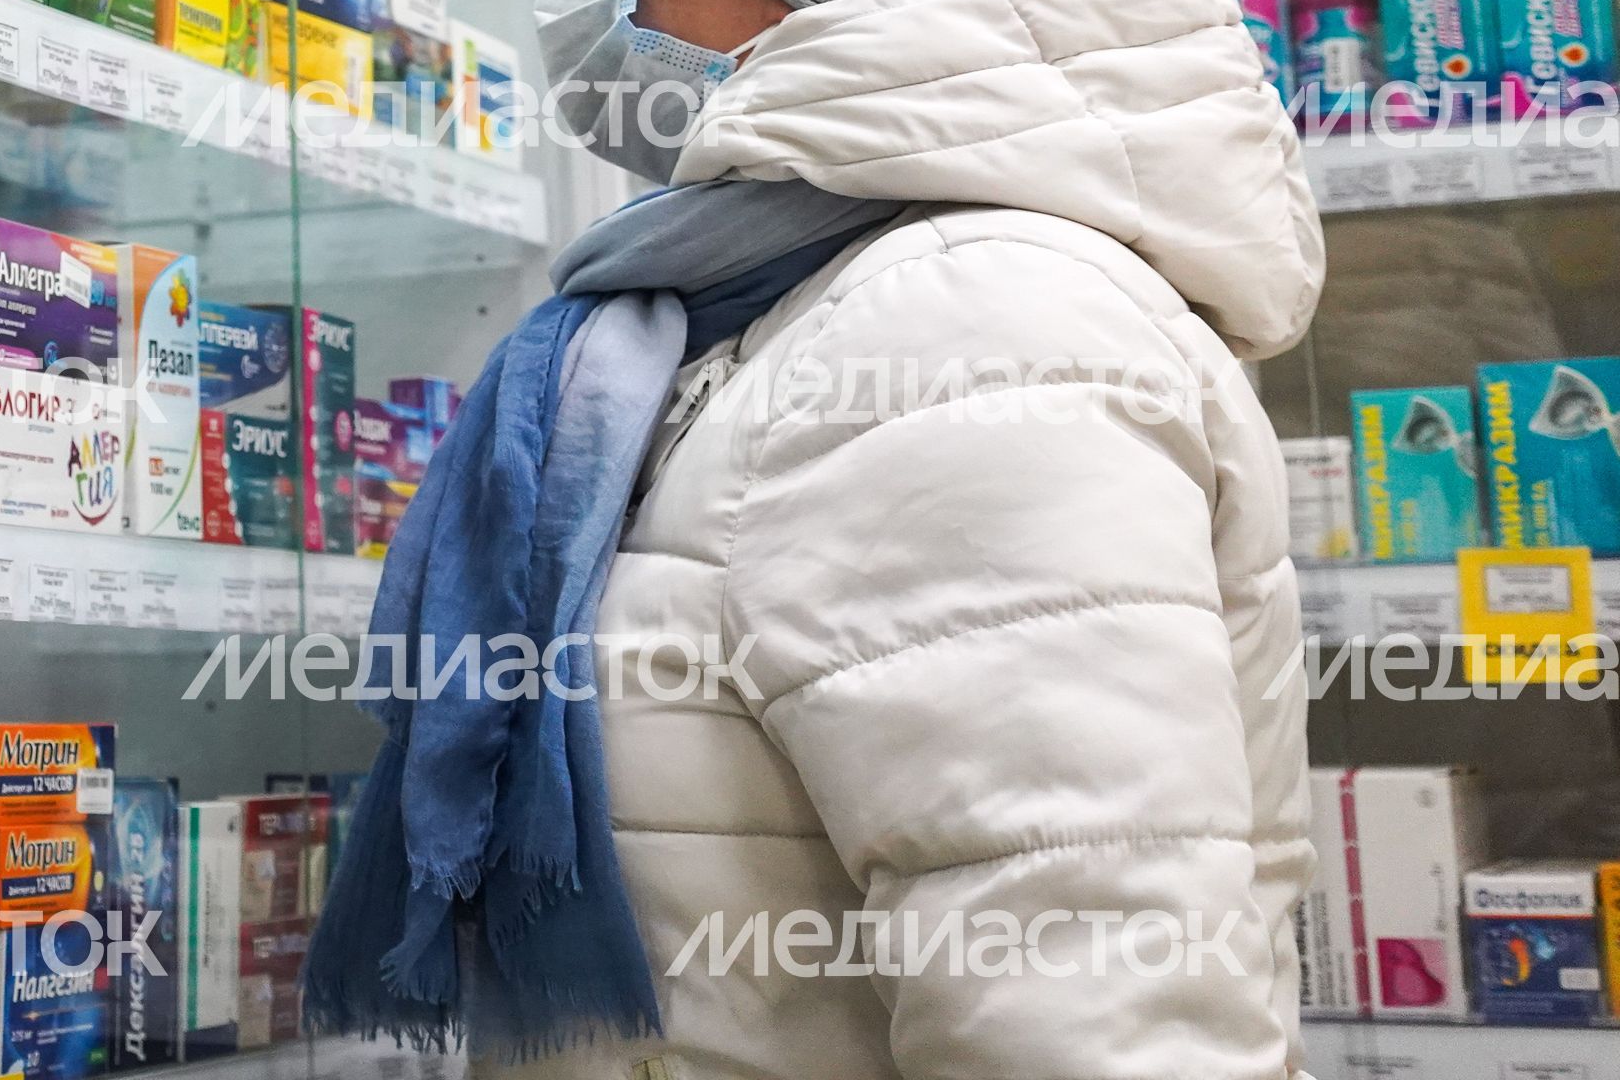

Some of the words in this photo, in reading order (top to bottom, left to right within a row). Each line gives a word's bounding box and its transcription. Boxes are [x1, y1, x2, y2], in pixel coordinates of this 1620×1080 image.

[148, 339, 193, 379] Дезал
[0, 733, 78, 771] Мотрин
[6, 835, 76, 870] Мотрин
